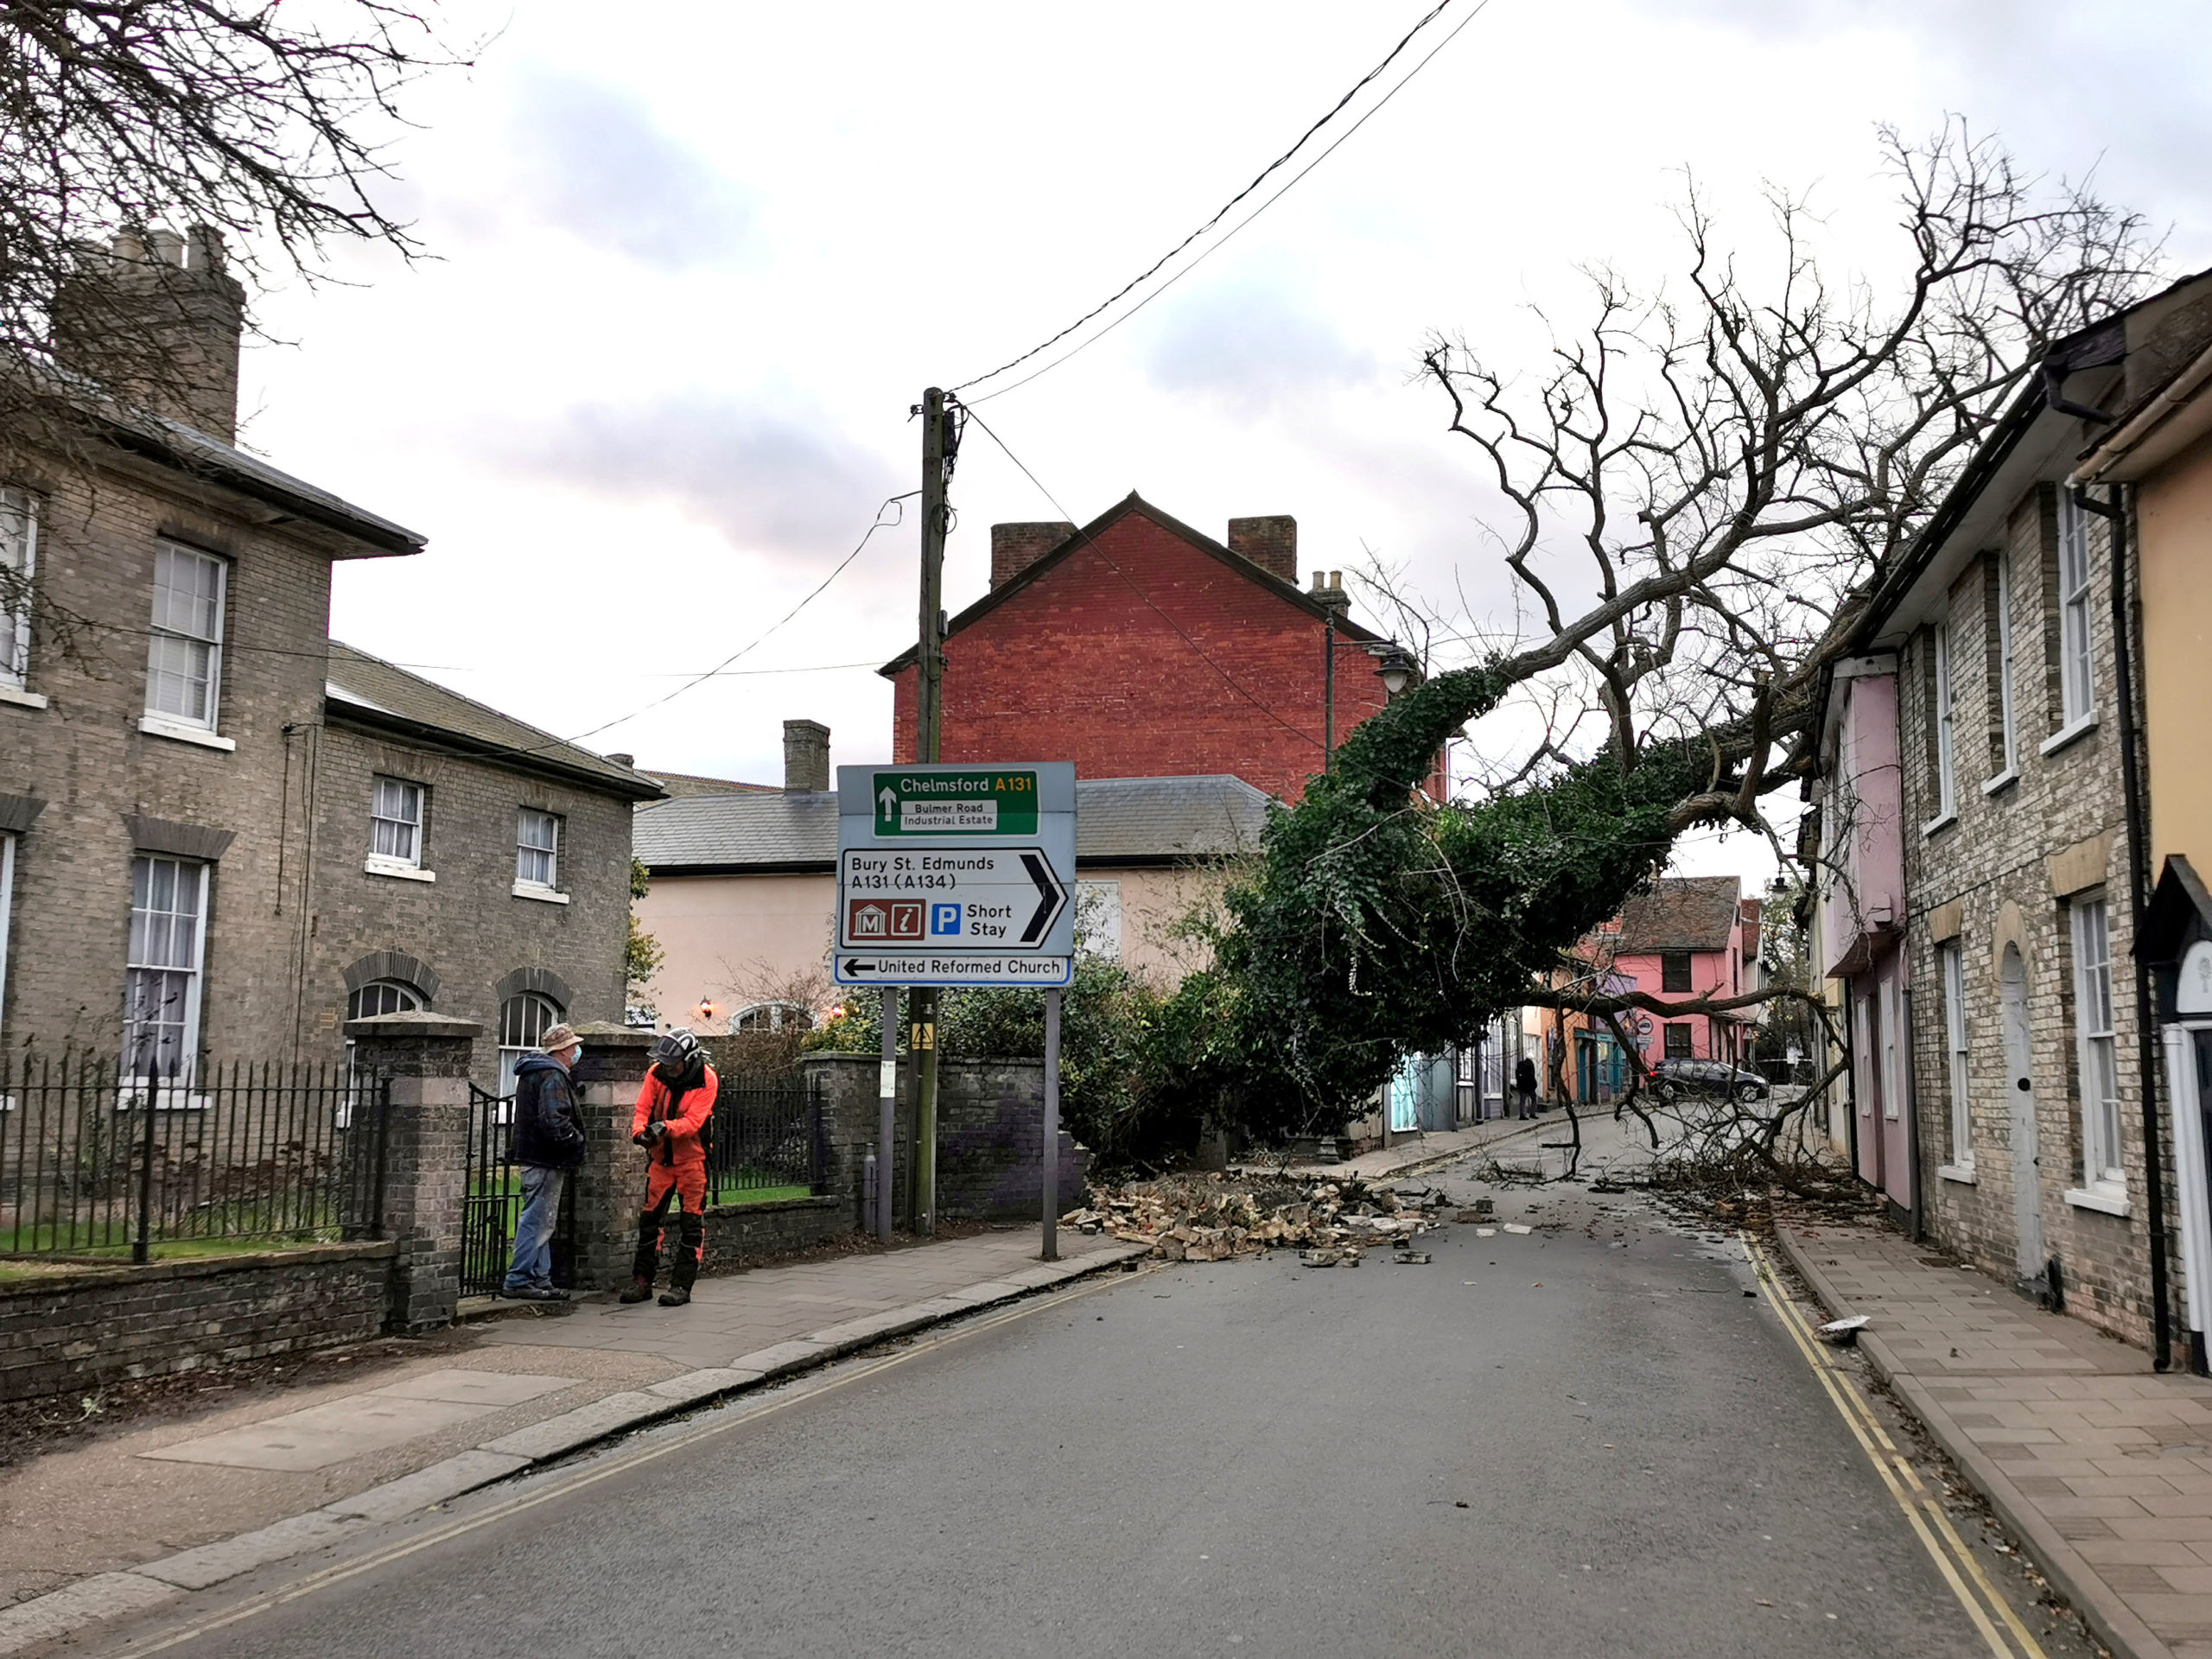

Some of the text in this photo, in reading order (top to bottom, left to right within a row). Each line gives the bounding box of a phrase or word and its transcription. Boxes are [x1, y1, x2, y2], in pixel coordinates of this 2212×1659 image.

[900, 778, 1032, 792] Chelmsford A131
[915, 804, 983, 814] Bulmer Road
[905, 816, 993, 825] Industrial Estate
[852, 856, 995, 873] Bury St. Edmunds
[852, 874, 888, 888] A131
[967, 904, 1012, 918] Short
[862, 915, 879, 932] M
[938, 906, 957, 932] P
[970, 922, 1007, 938] Stay
[878, 959, 1060, 974] United Reformed Church
